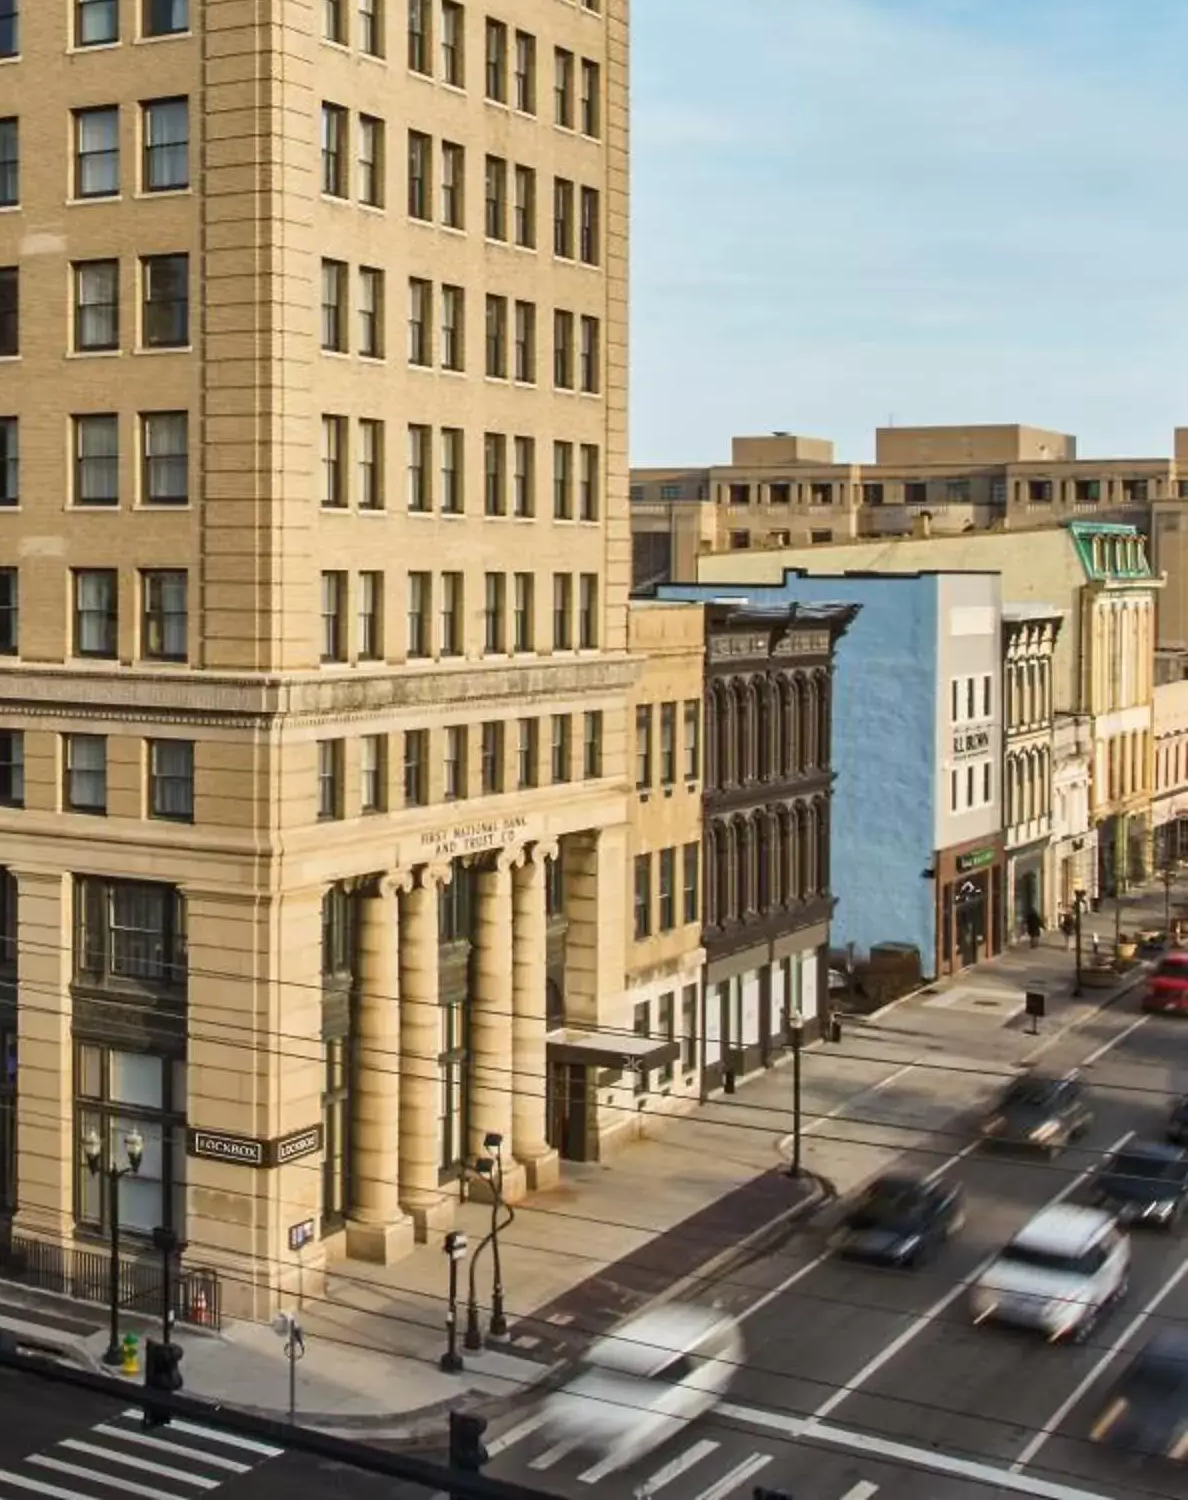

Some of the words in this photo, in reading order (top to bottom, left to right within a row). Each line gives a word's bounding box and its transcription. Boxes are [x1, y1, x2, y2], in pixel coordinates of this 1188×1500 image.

[421, 832, 449, 845] FIRST
[453, 821, 498, 837] NATIONAL
[503, 816, 527, 831] BANK
[435, 841, 457, 854] AND
[464, 833, 494, 850] TRUST
[199, 1139, 258, 1158] LOCKBOX
[280, 1137, 315, 1157] LOCKBOX
